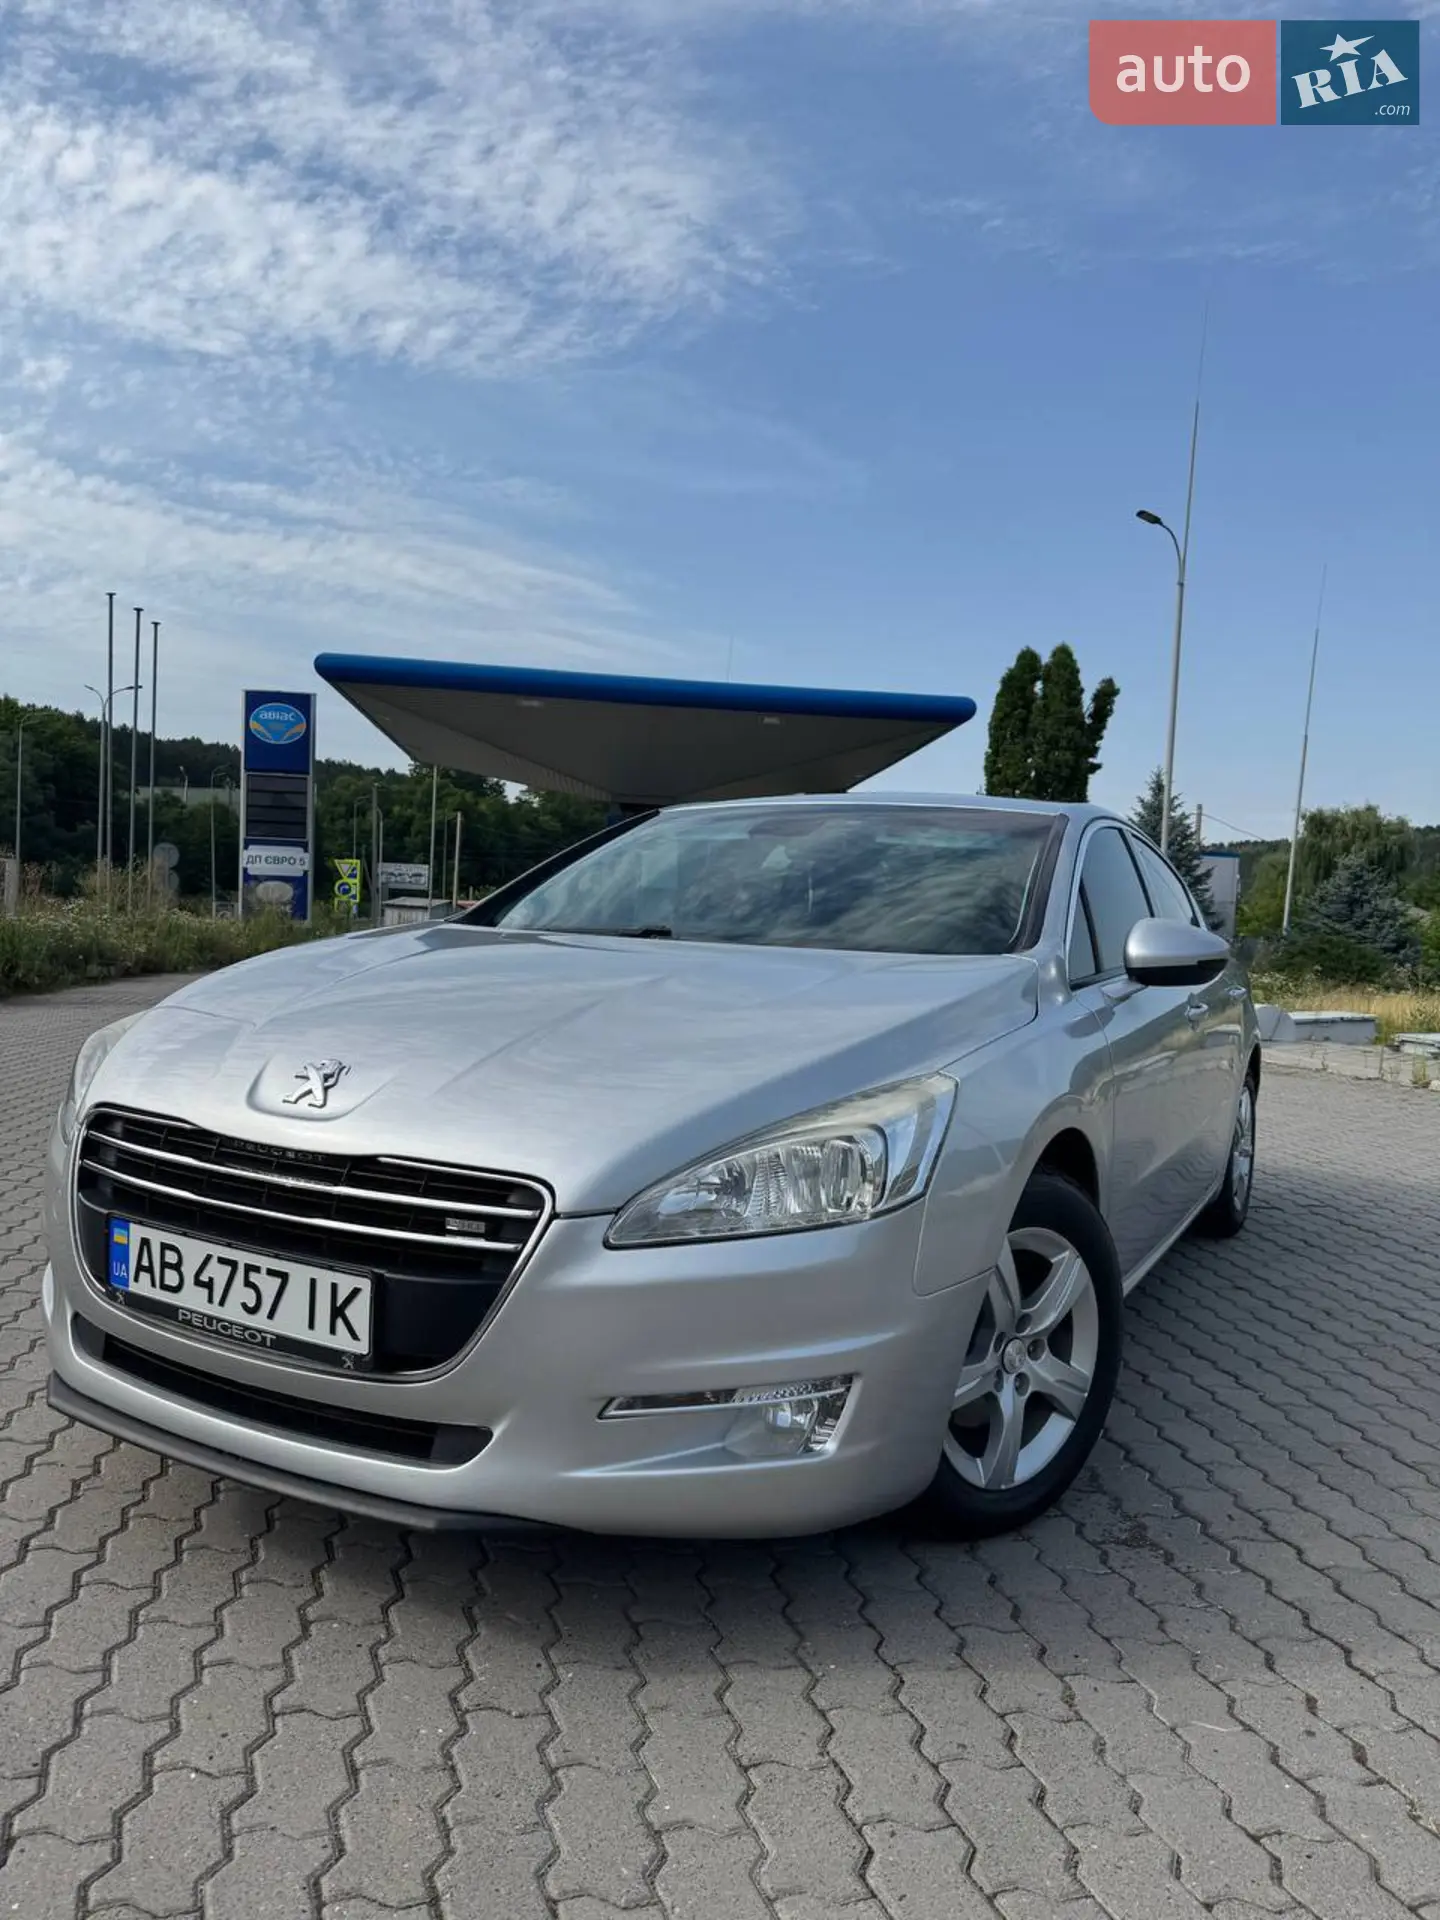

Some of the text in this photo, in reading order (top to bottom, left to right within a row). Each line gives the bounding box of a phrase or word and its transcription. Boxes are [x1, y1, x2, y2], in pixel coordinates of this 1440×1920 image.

[246, 854, 262, 866] ДП
[264, 855, 297, 866] ЄВРО
[113, 1261, 128, 1278] UA
[133, 1236, 363, 1342] AB 4757 IK
[177, 1308, 277, 1348] PEUGEOT
